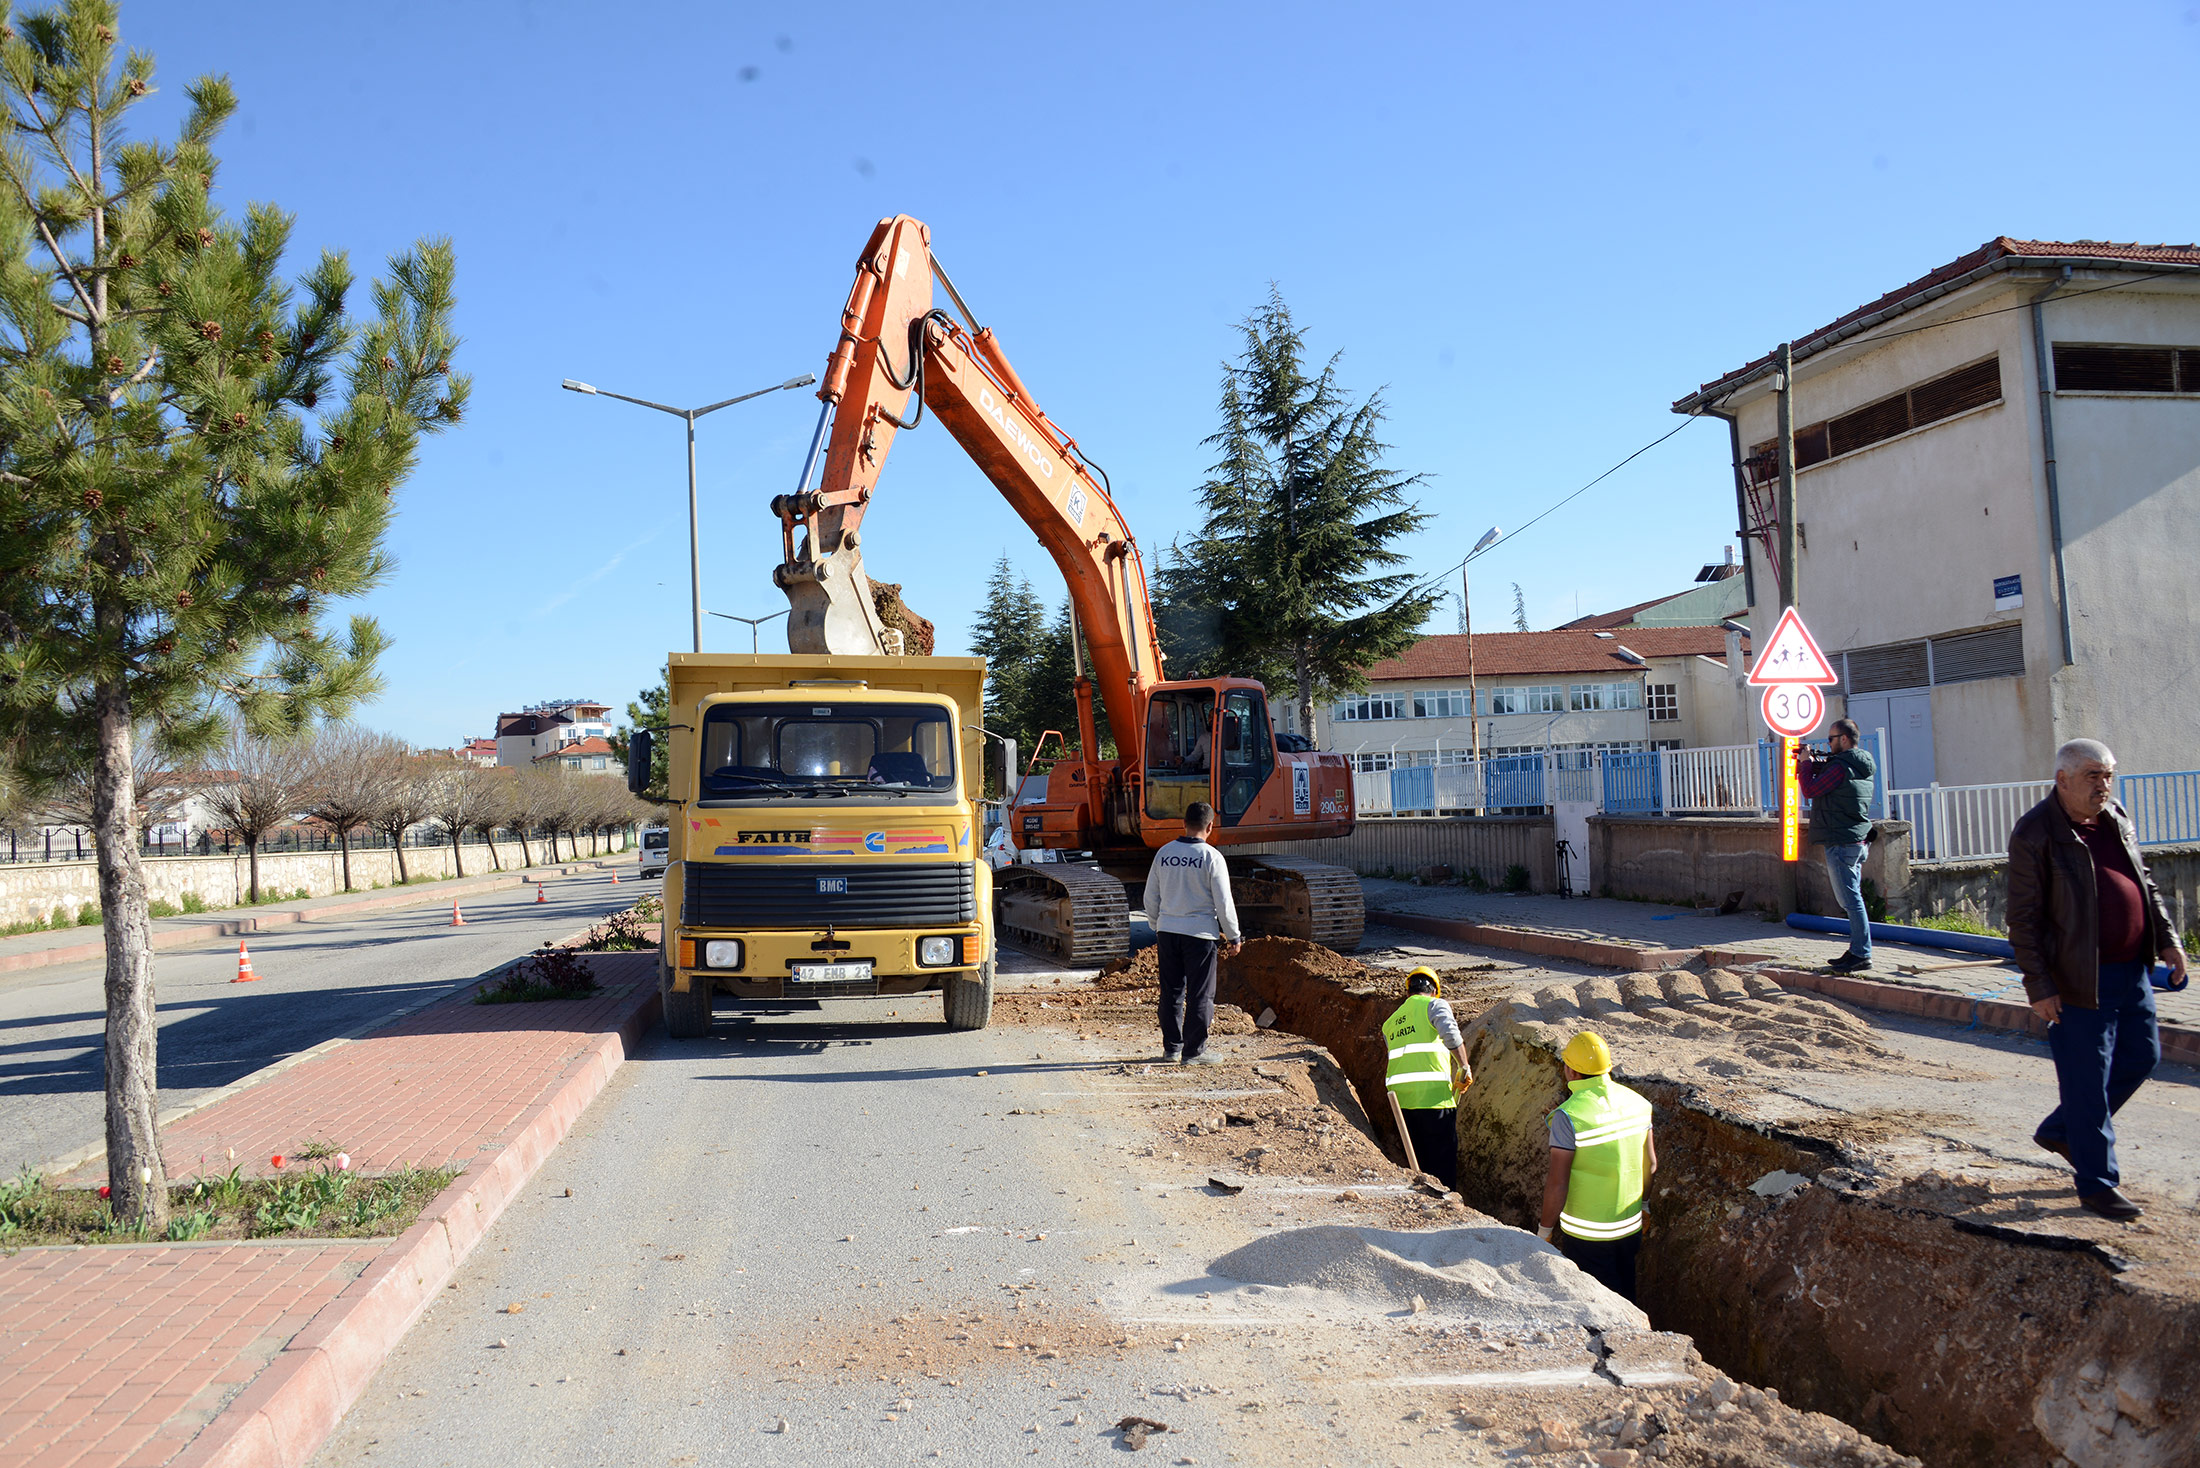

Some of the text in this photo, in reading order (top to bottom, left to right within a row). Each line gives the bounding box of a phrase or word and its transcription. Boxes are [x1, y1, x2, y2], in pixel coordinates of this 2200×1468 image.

[980, 388, 1053, 478] DAEWOO
[1776, 693, 1811, 719] 30
[1161, 856, 1203, 869] KOSKİ
[819, 880, 844, 892] BMC
[801, 968, 815, 980] 42
[855, 966, 869, 978] 23
